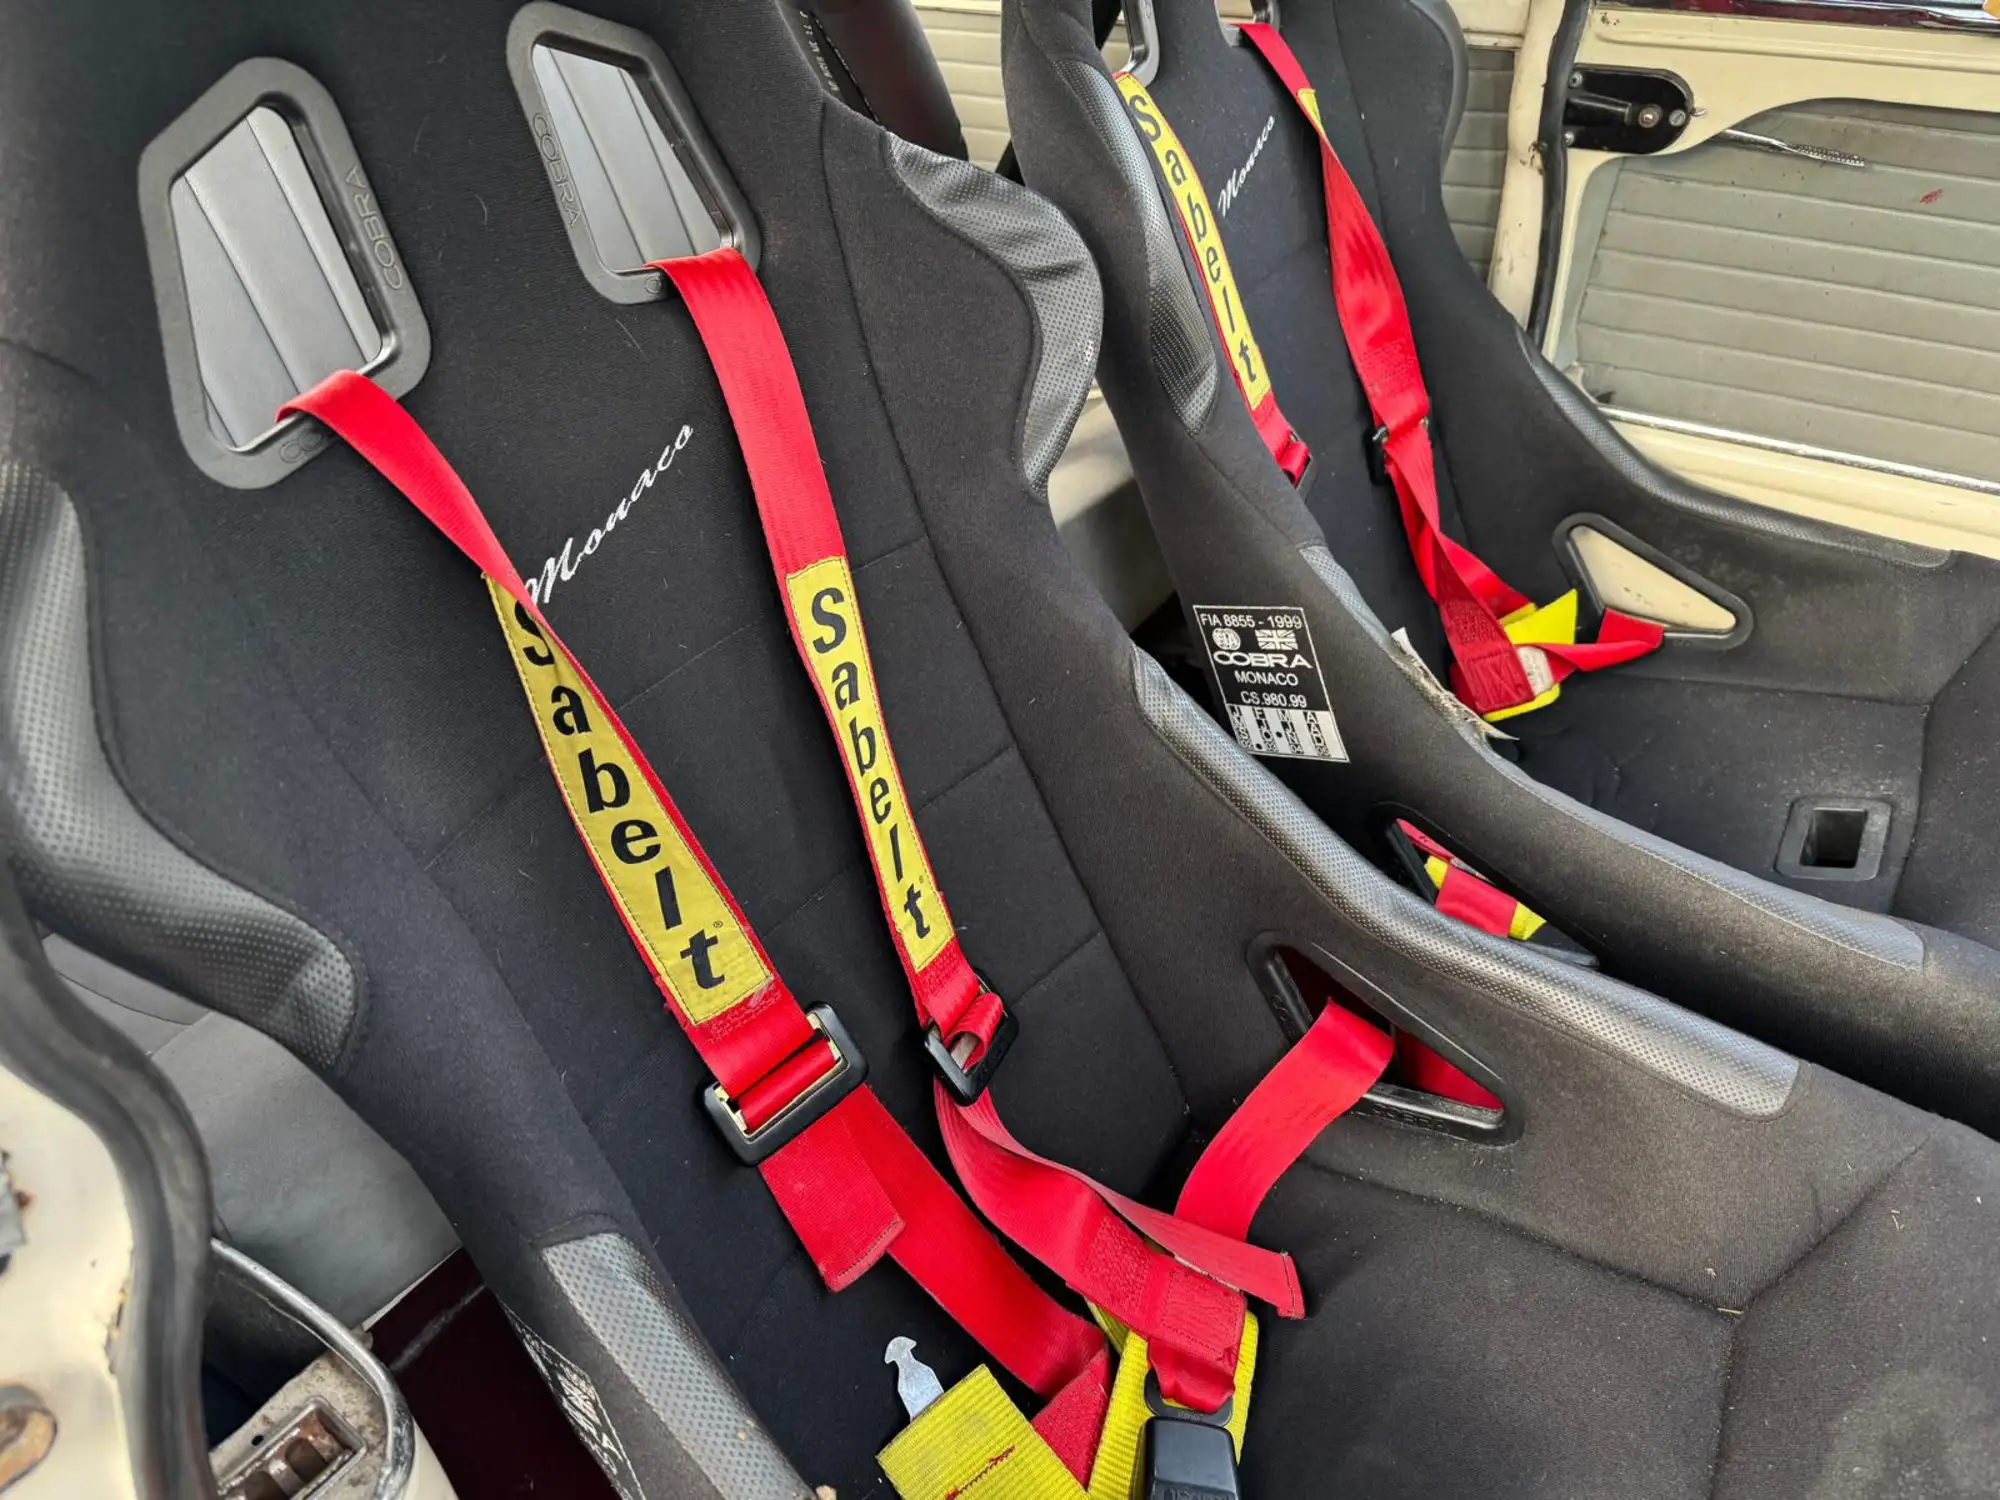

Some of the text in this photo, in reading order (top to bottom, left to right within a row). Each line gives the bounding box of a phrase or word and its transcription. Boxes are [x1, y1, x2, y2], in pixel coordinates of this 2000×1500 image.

[532, 111, 582, 229] COBRA
[1216, 115, 1276, 218] Monaco
[345, 164, 404, 290] COBRA
[1129, 94, 1257, 383] Sabelt
[524, 424, 694, 606] Monaco
[1201, 614, 1222, 626] FIA
[1223, 614, 1255, 628] 8855
[1267, 615, 1302, 629] 1999
[1213, 651, 1314, 668] COBRA
[1234, 670, 1298, 686] MONACO
[1240, 691, 1307, 708] CS.980.99
[811, 586, 932, 941] Sabelt
